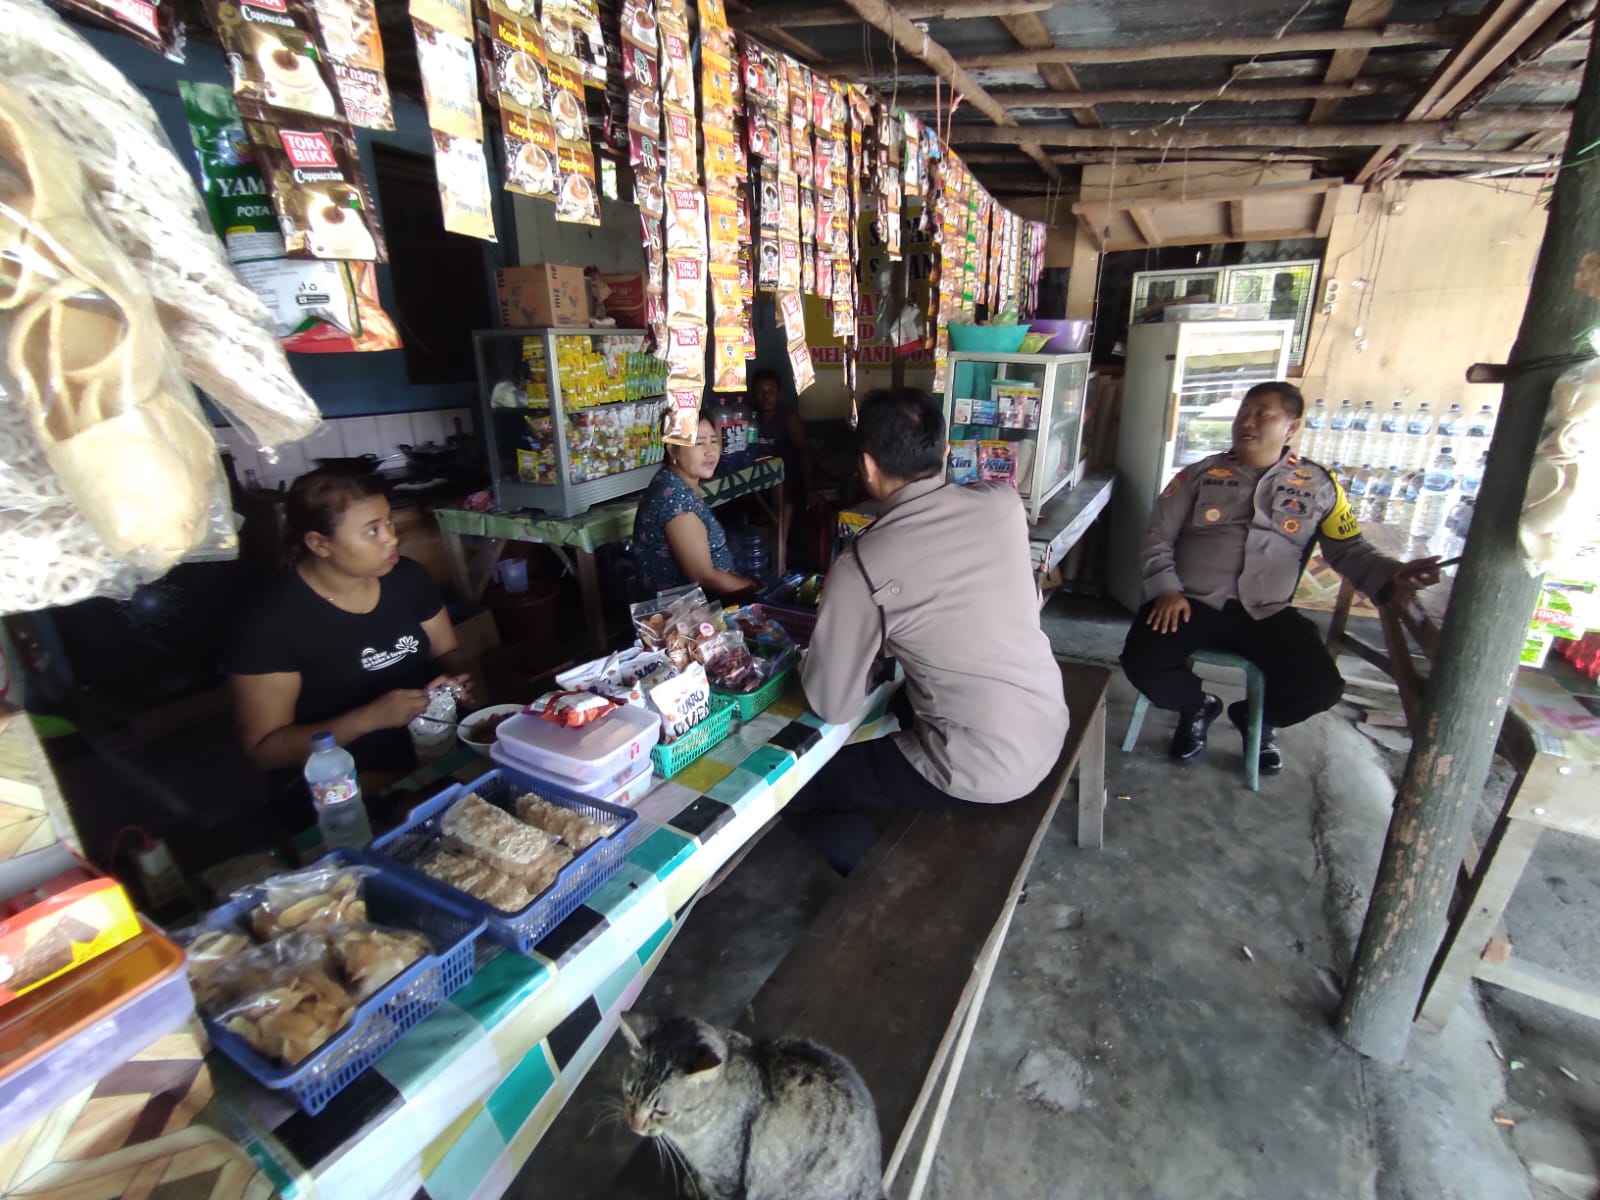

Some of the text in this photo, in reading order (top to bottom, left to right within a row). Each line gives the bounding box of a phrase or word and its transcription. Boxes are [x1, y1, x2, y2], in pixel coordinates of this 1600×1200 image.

[241, 5, 296, 28] Cappuccino
[285, 135, 327, 150] TORA
[293, 149, 332, 163] BIKA
[294, 169, 344, 183] Cappuccino
[216, 176, 267, 198] YAM
[675, 191, 694, 201] TORA
[678, 200, 697, 209] BIKA
[237, 205, 271, 217] POTA
[677, 260, 697, 270] TORA
[679, 269, 698, 280] BIKA
[679, 329, 698, 338] TORA
[680, 337, 699, 345] BIKA
[1276, 485, 1317, 500] POLRI
